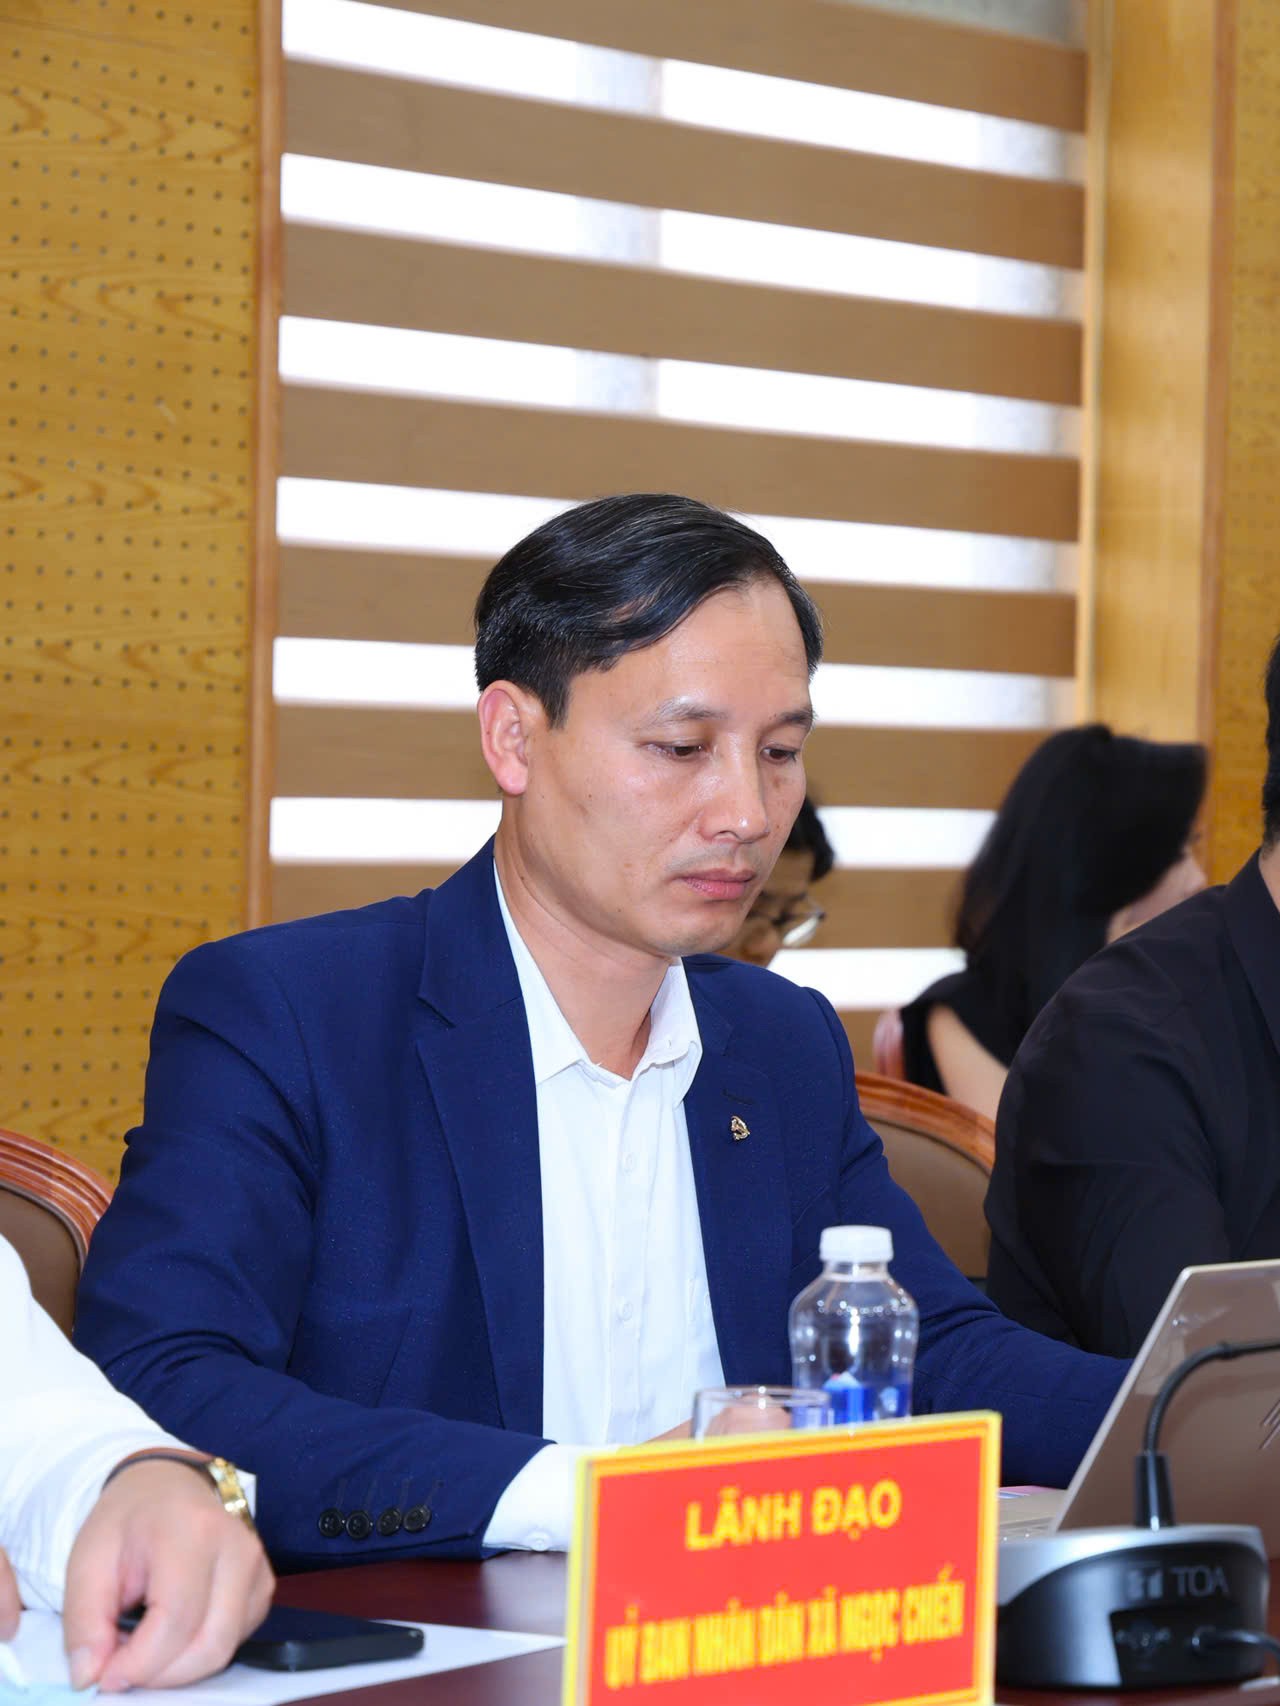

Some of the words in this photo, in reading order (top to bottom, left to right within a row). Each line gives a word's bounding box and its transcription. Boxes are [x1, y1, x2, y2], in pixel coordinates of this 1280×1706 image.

[685, 1485, 802, 1551] LÃNH
[812, 1478, 903, 1542] ĐẠO
[1170, 1564, 1230, 1598] TOA
[639, 1618, 691, 1685] BAN
[692, 1595, 756, 1678] NHÂN
[757, 1589, 806, 1668] DÂN
[806, 1584, 838, 1660] XÃ
[839, 1587, 901, 1664] NGỌC
[902, 1561, 966, 1645] CHIẾN
